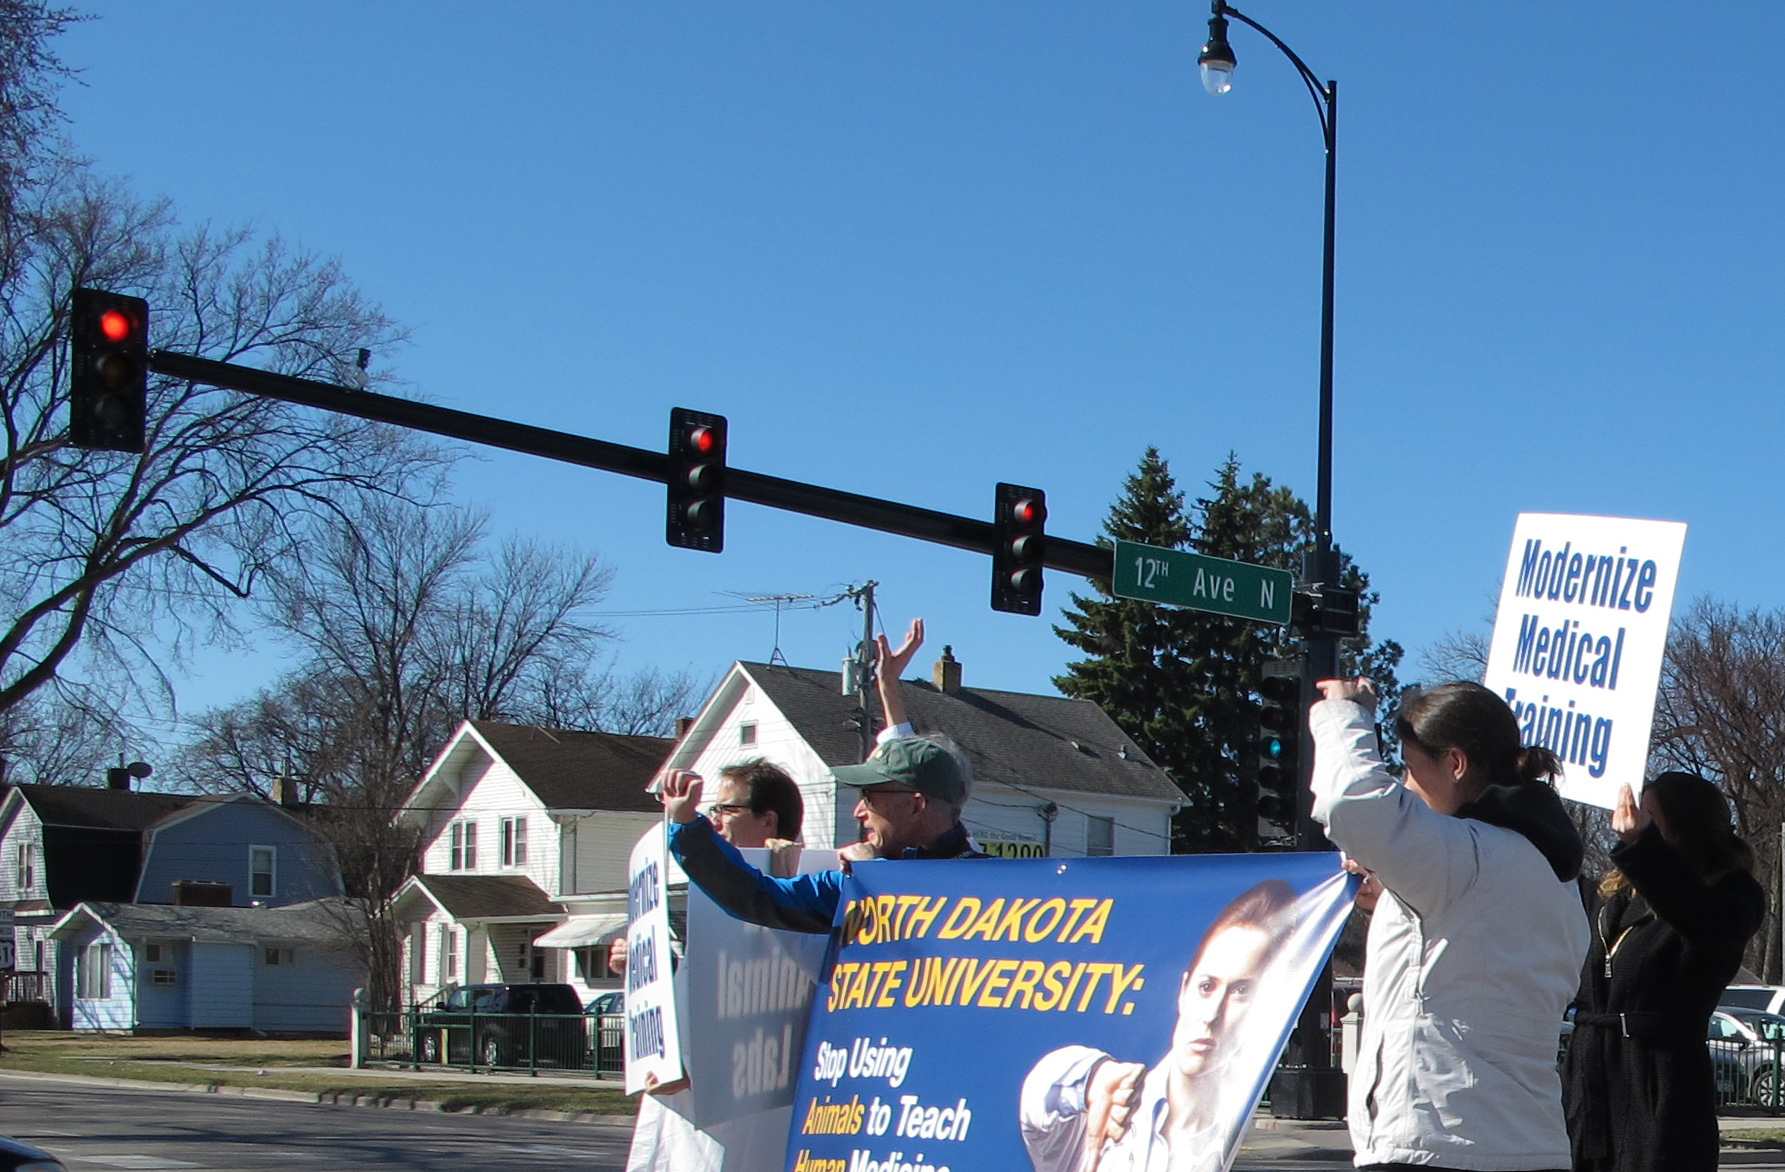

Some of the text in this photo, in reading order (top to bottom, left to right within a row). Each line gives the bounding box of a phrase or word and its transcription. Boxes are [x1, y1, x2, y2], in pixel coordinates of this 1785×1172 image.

[1134, 556, 1274, 610] 12TH Ave N
[1515, 538, 1657, 613] Modernize
[1513, 613, 1626, 690] Medical
[845, 894, 1114, 945] NORTH DAKOTA
[828, 957, 1145, 1015] STATE UNIVERSITY:
[814, 1037, 914, 1088] Stop Using
[802, 1094, 972, 1141] Animals to Teach
